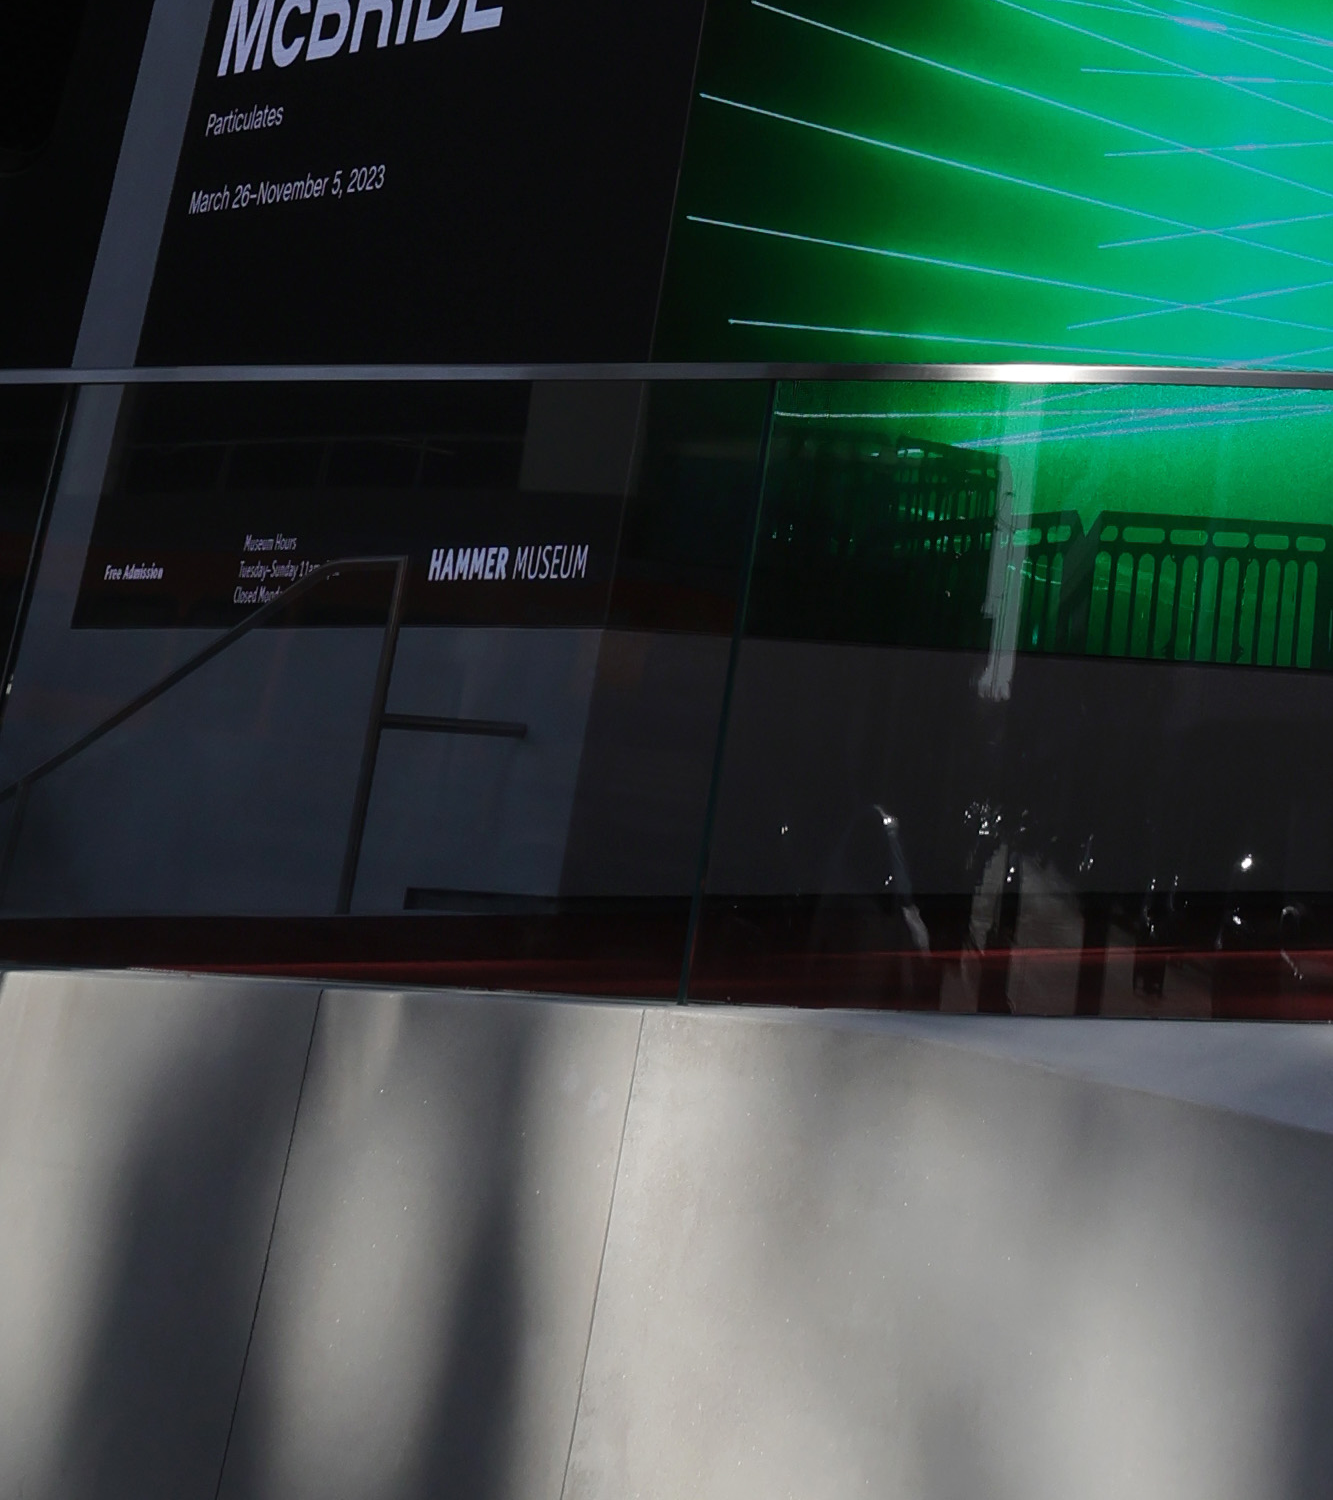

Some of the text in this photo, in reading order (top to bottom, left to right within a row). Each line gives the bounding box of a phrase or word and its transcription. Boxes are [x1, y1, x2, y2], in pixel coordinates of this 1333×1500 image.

[205, 103, 285, 138] Particulates
[188, 185, 231, 215] March
[332, 170, 344, 199] 5,
[347, 164, 387, 193] 2023
[243, 533, 298, 551] Museum Hours
[104, 562, 165, 581] Free Admission
[427, 544, 590, 581] HAMMER MUSEUM
[233, 586, 258, 604] Closed
